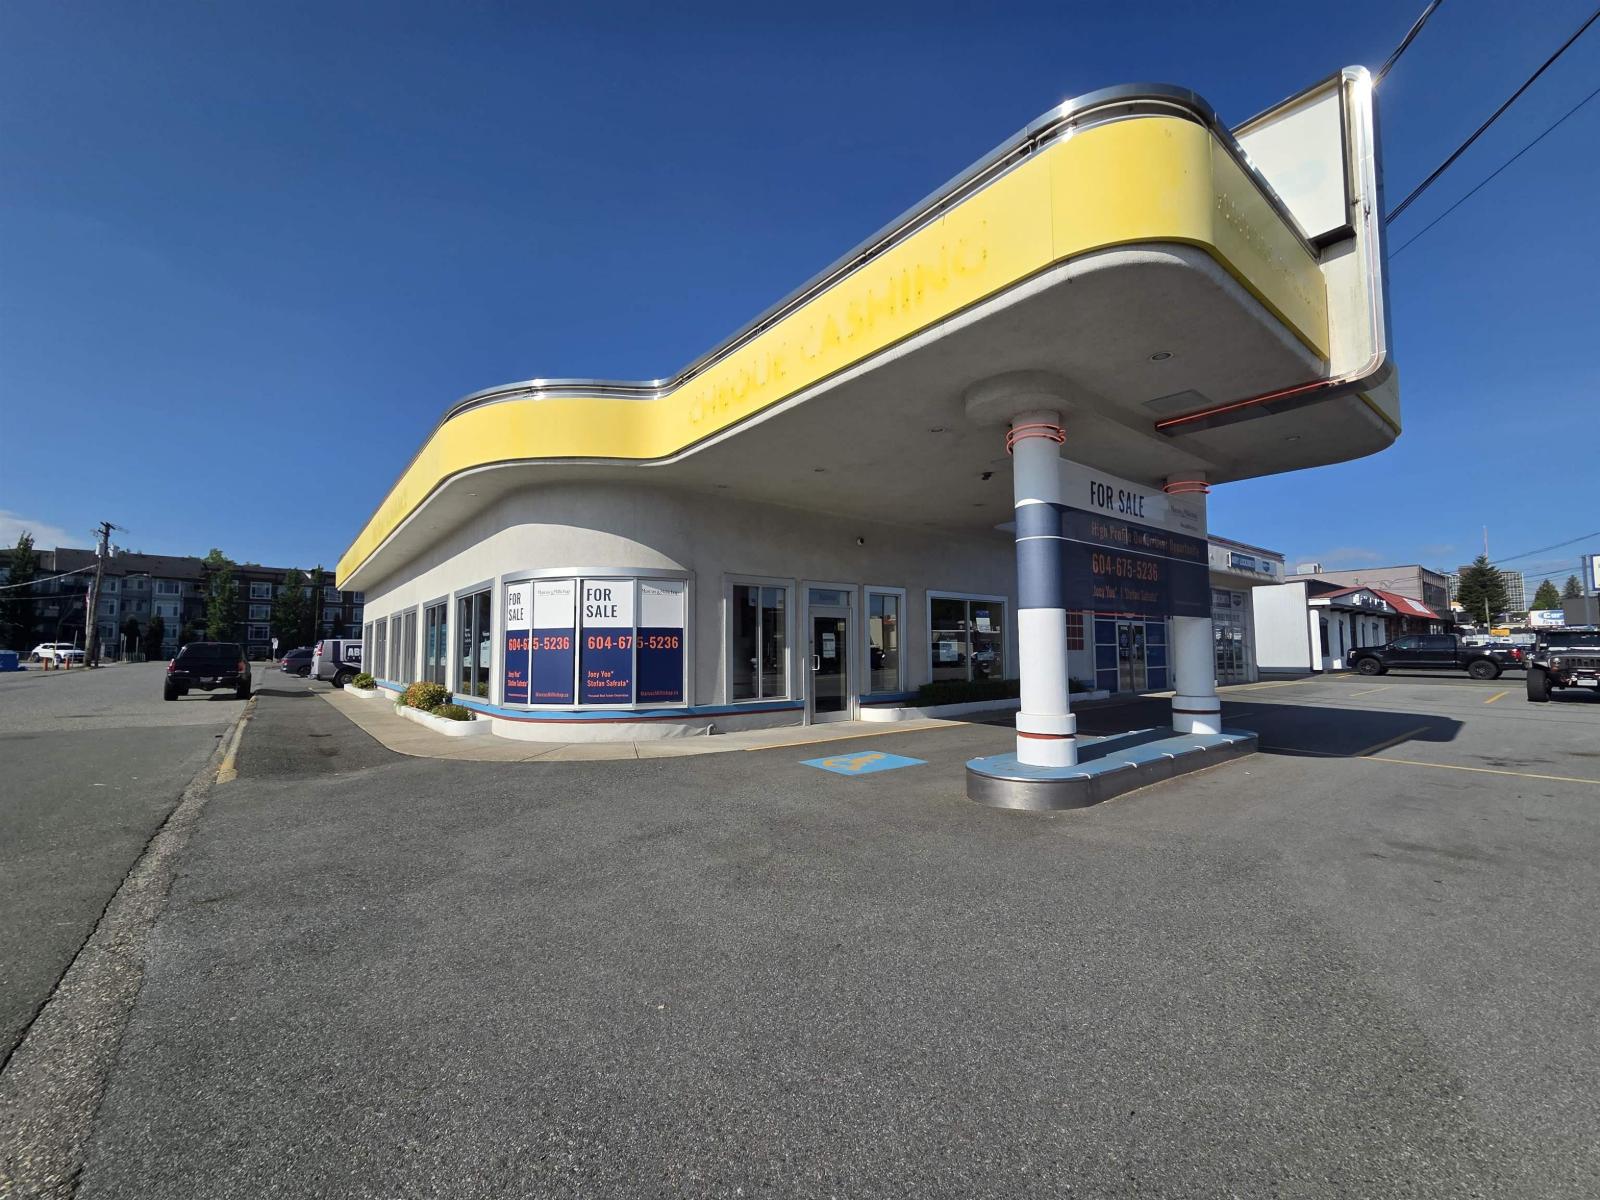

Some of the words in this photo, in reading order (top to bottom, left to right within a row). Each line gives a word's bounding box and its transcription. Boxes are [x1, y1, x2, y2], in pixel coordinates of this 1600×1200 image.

[1090, 480, 1114, 511] FOR
[1118, 489, 1145, 518] SALE
[1093, 554, 1158, 581] 604-675-5236
[509, 592, 521, 605] FOR
[586, 588, 612, 602] FOR
[509, 607, 523, 621] SALE
[586, 604, 618, 618] SALE
[587, 636, 679, 650] 604-675-5236
[348, 648, 362, 656] AB
